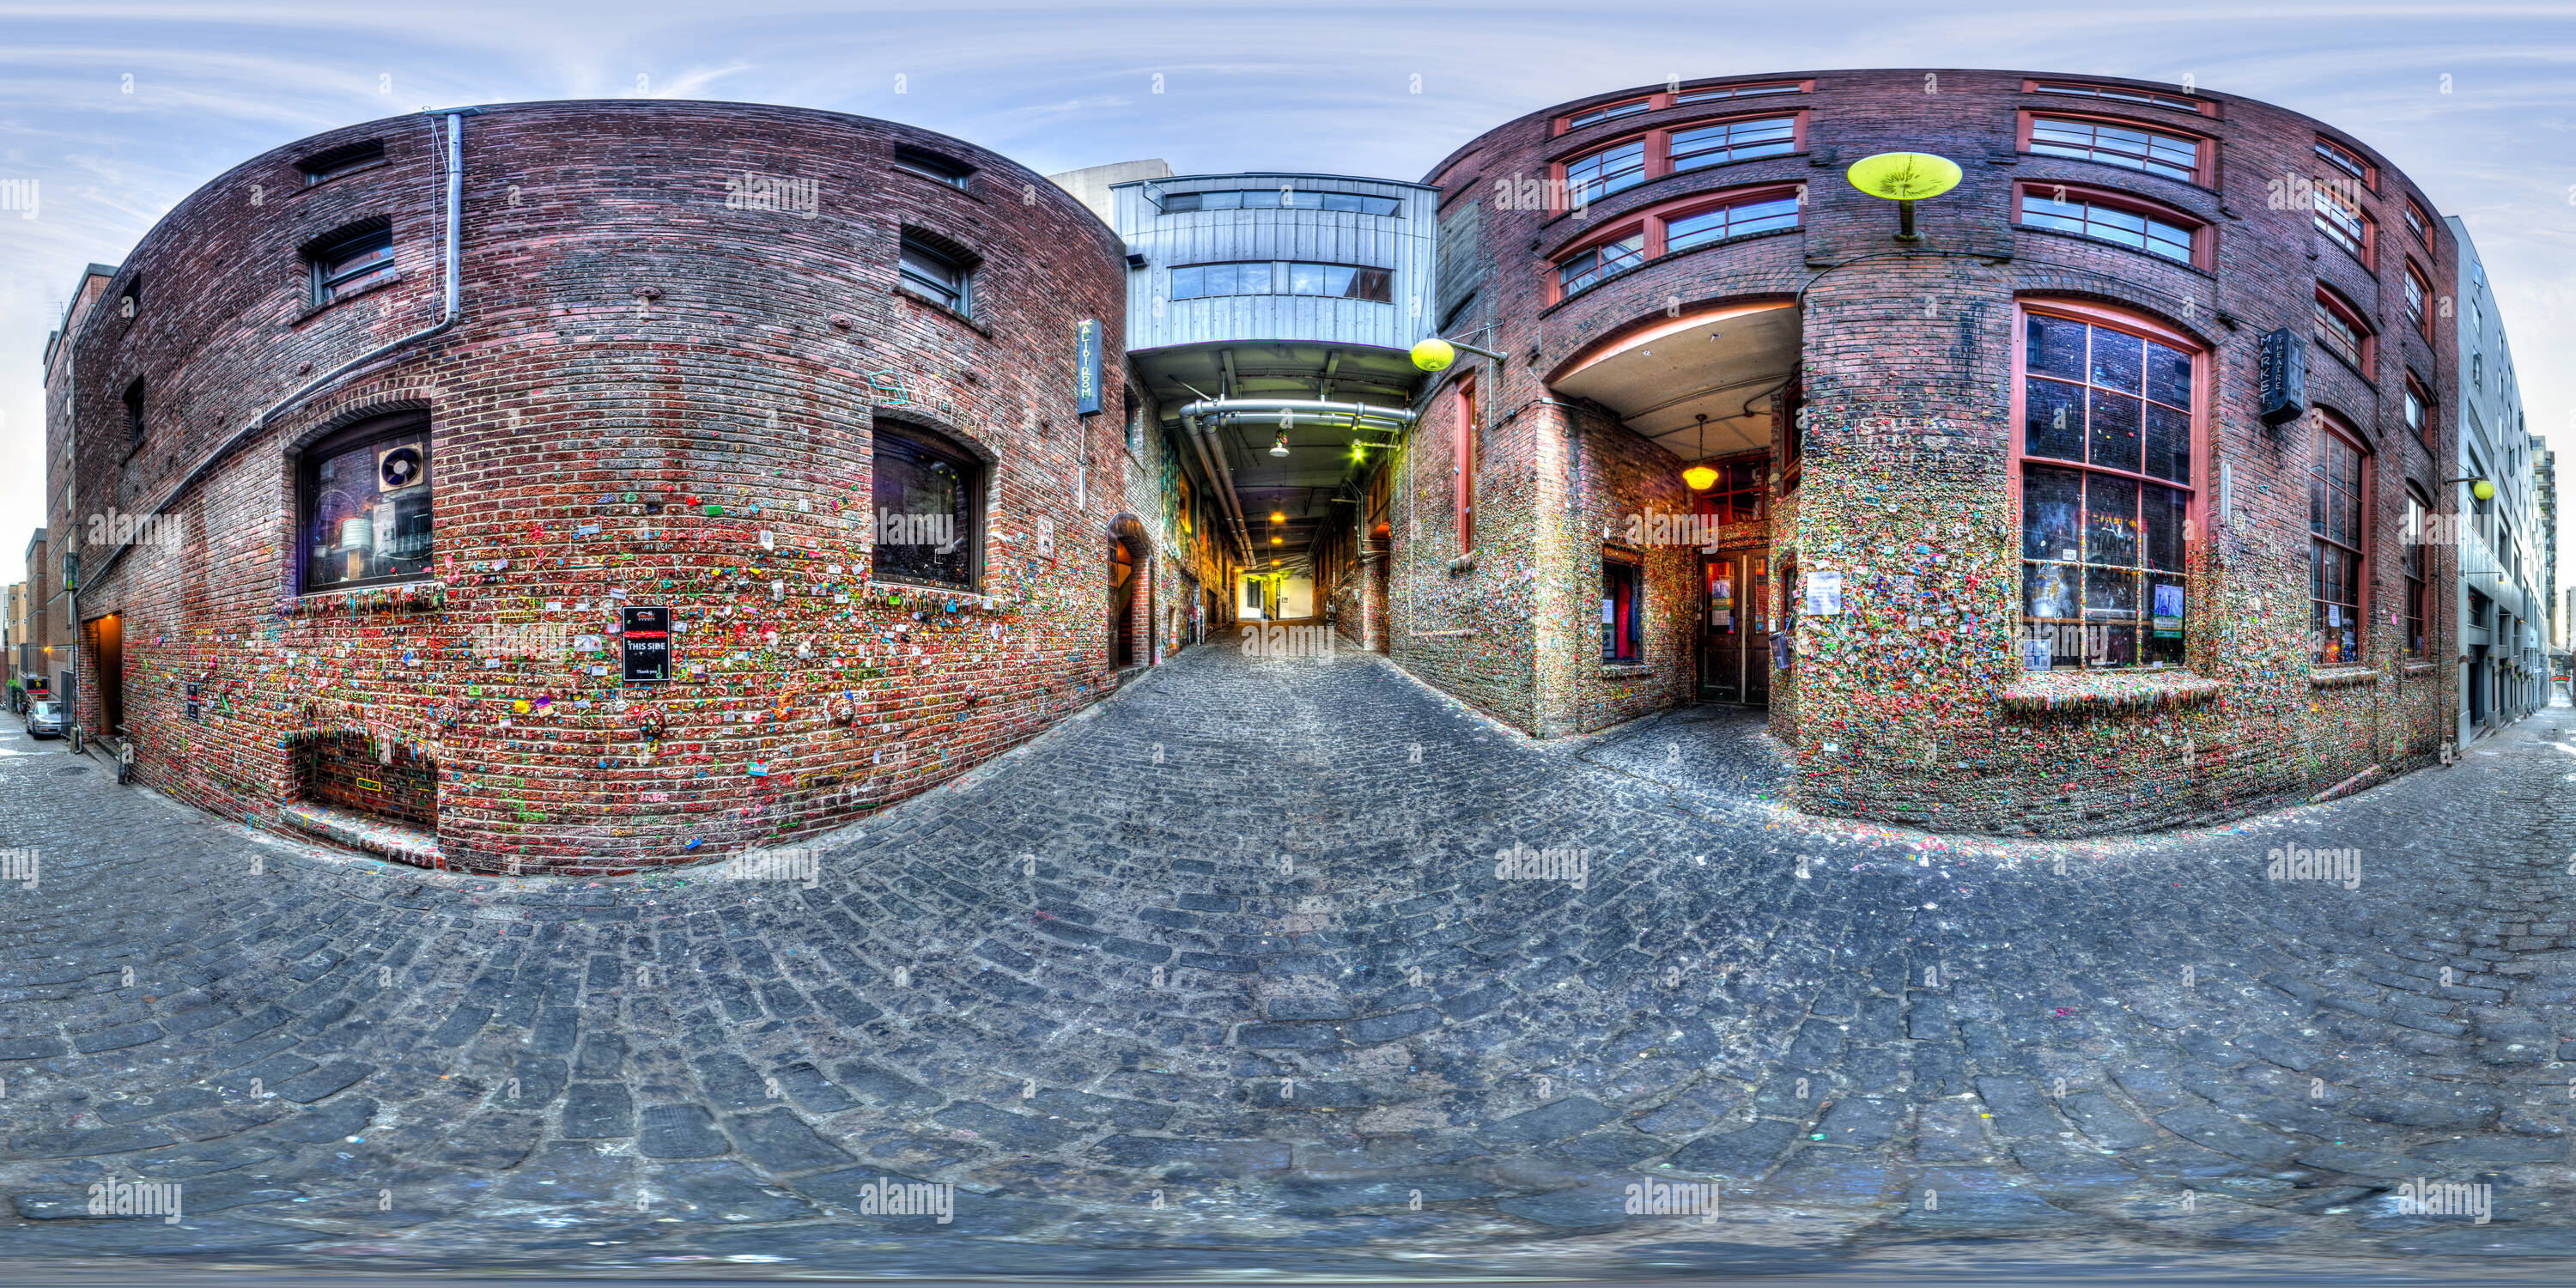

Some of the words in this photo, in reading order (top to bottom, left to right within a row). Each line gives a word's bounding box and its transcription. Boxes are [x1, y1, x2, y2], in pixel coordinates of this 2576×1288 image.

[1078, 319, 1093, 327] THE
[2259, 334, 2272, 404] MARKET
[2275, 336, 2284, 390] THEATRE
[1081, 368, 1091, 398] ROOM
[628, 642, 647, 651] THIS
[647, 642, 666, 651] SIDE
